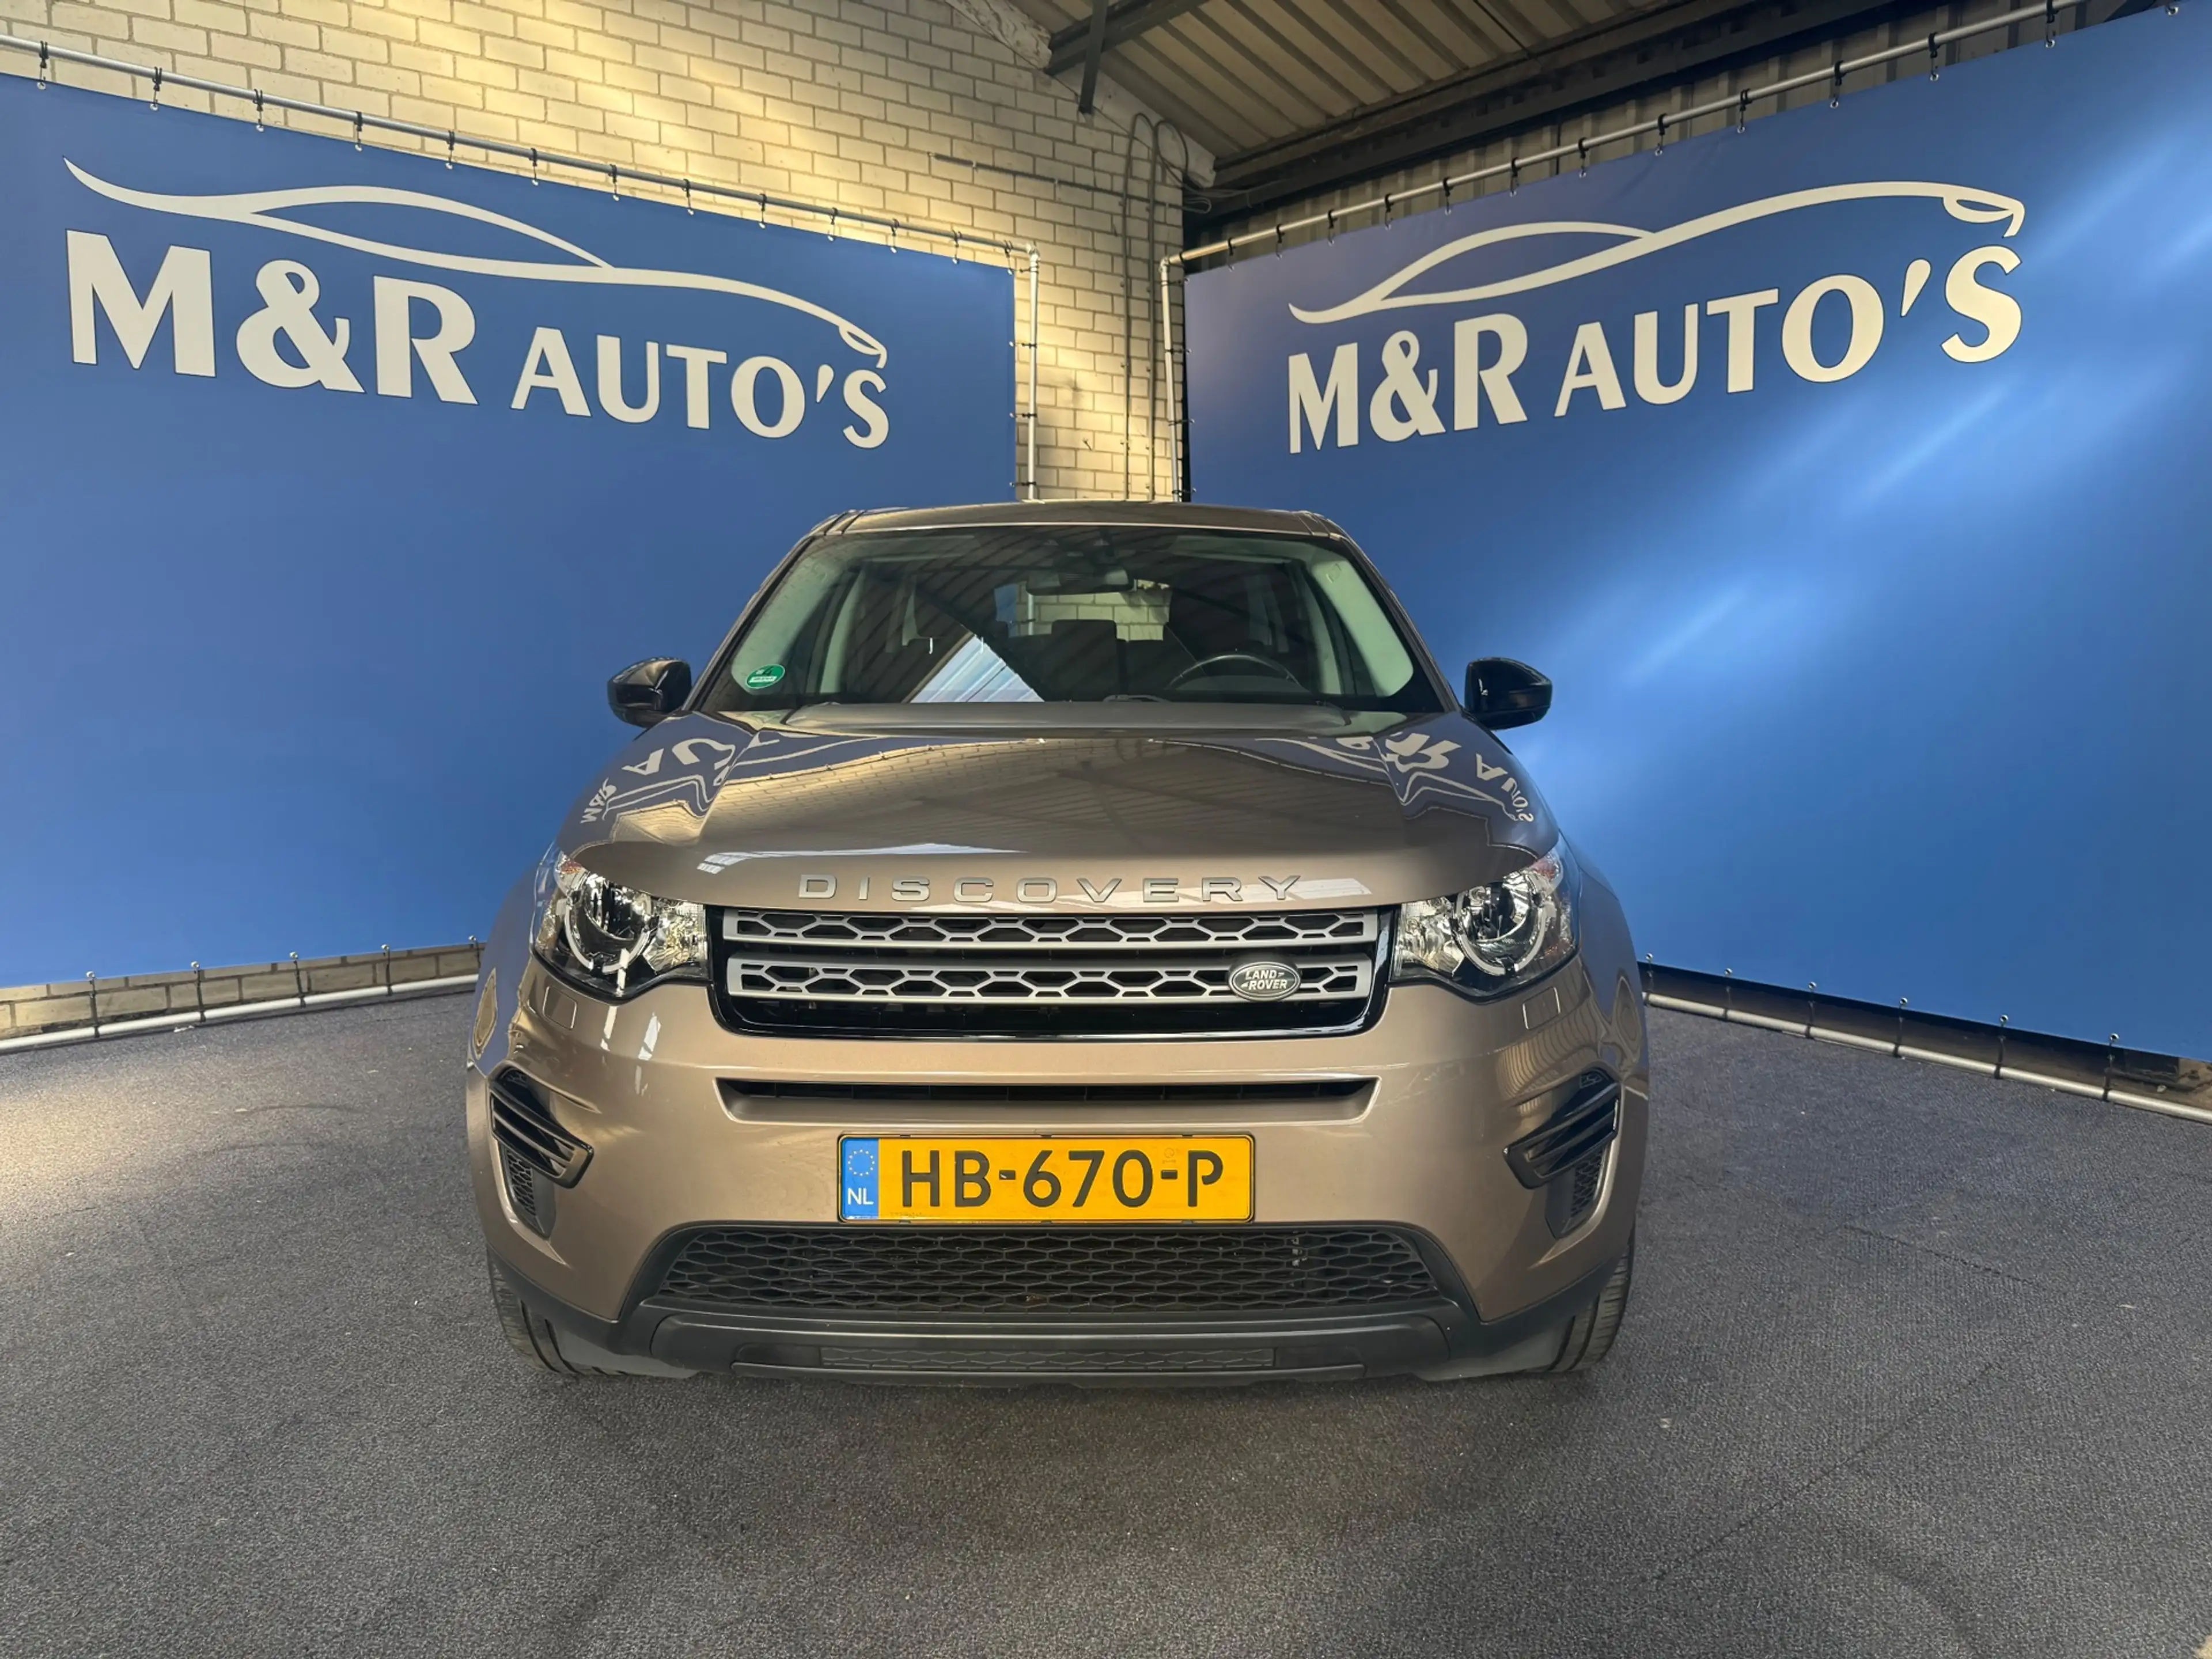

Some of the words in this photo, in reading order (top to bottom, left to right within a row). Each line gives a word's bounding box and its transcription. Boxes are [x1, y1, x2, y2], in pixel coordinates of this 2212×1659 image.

[66, 229, 478, 405] M&R
[510, 326, 889, 449] AUTO'S
[1289, 313, 1528, 454] M&R
[1554, 245, 2022, 417] AUTO'S
[798, 874, 1301, 903] DISCOVERY
[1245, 969, 1278, 980] LAND
[1248, 979, 1288, 990] ROVER
[847, 1187, 874, 1205] NL
[902, 1150, 1224, 1207] HB-670-P
